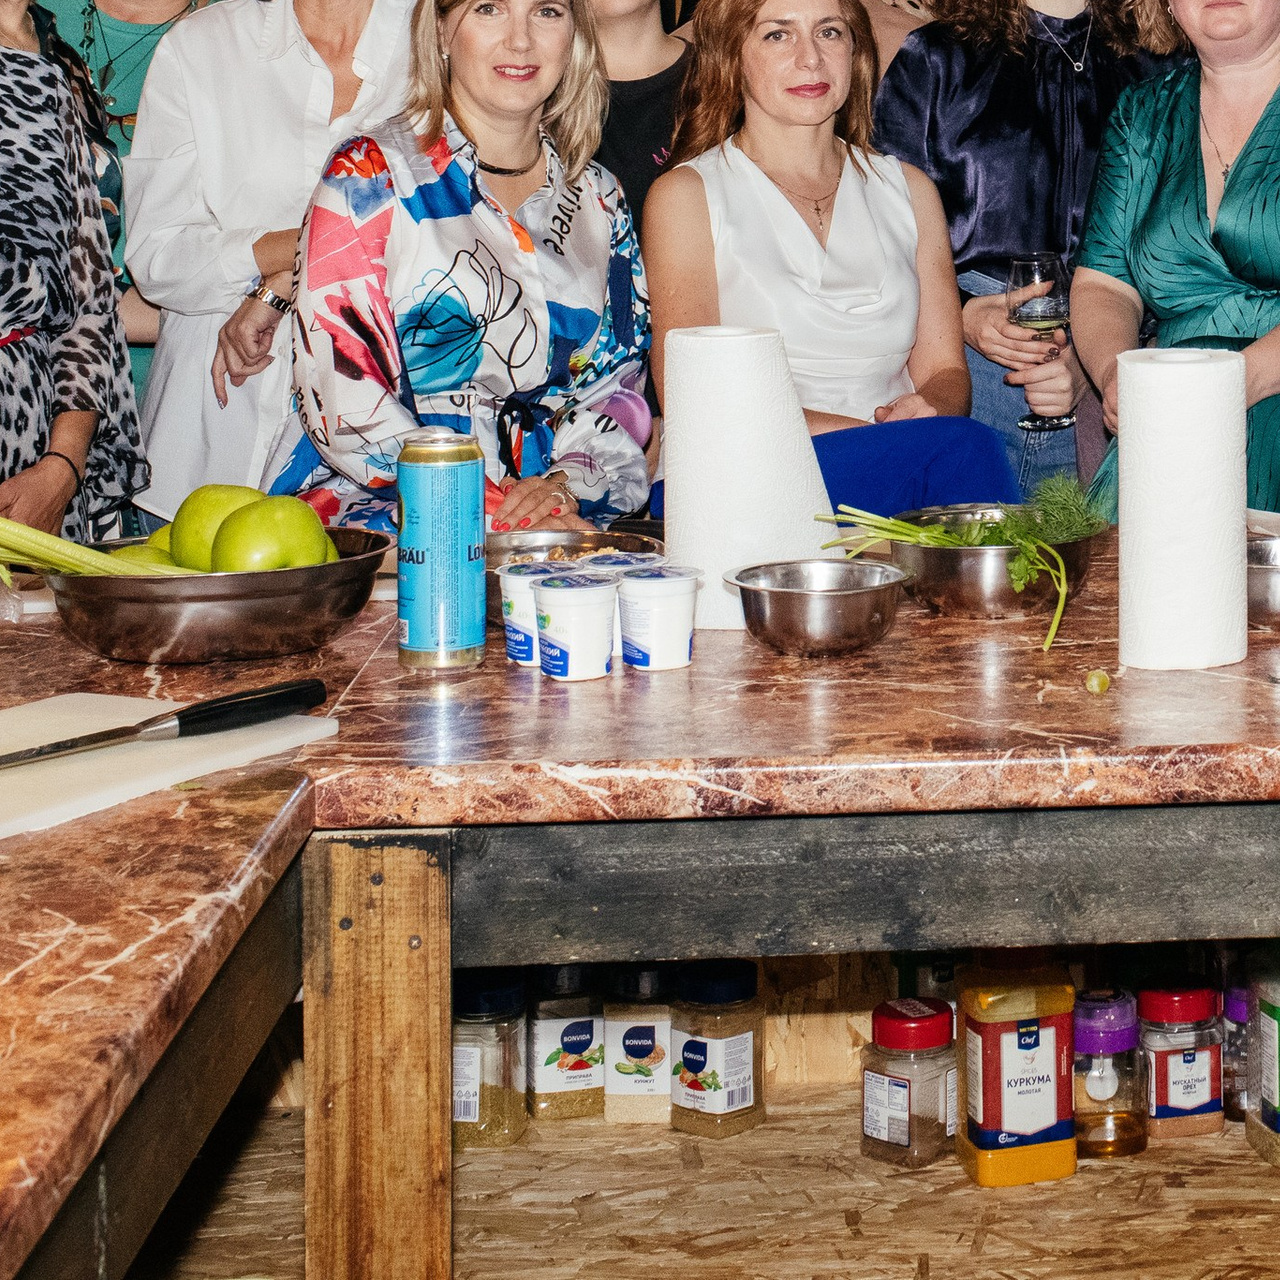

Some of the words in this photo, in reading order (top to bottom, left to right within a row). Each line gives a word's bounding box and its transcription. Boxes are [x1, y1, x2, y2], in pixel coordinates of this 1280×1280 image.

[563, 1033, 591, 1043] BONVIDA
[1021, 1034, 1037, 1045] Chef
[1006, 1074, 1052, 1089] КУРКУМА
